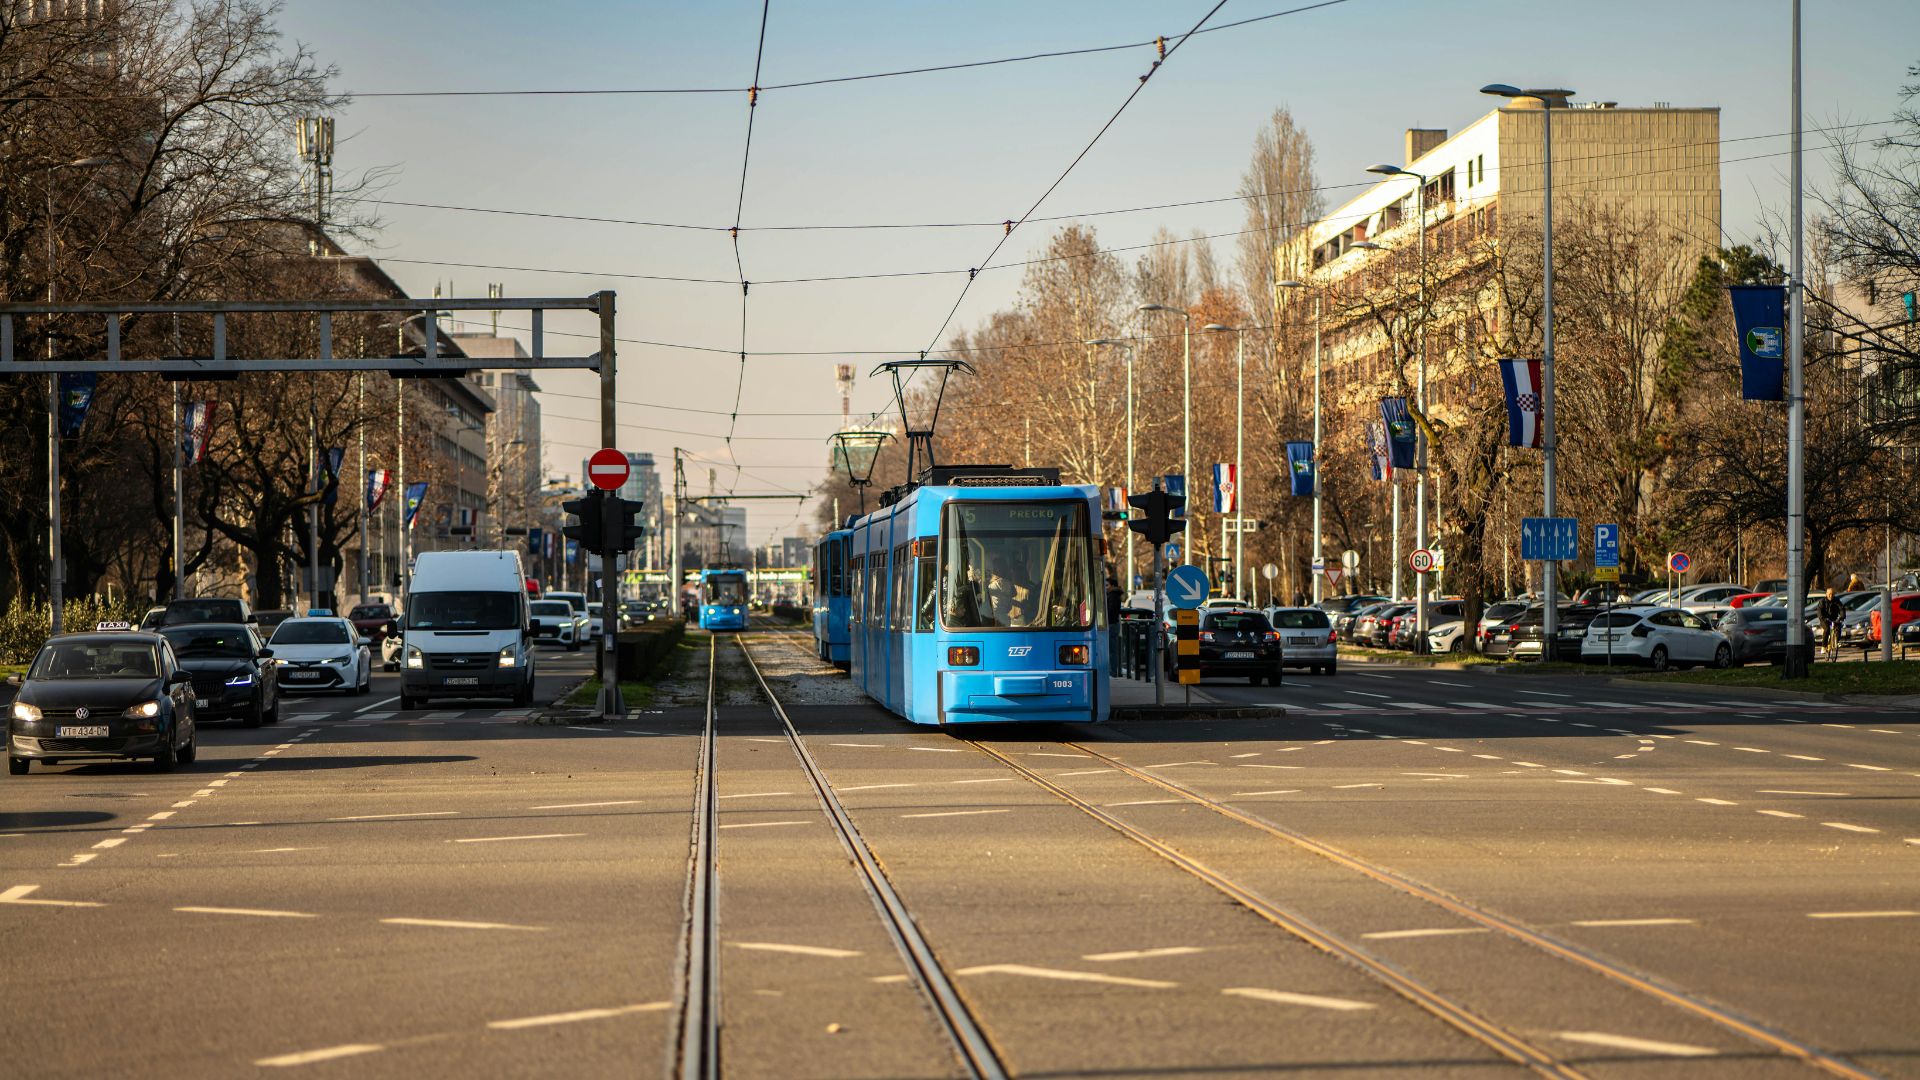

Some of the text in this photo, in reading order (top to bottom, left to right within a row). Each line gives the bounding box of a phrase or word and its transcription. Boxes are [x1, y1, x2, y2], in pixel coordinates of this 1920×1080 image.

[965, 508, 976, 524] 5
[1597, 527, 1609, 547] P
[1414, 555, 1428, 567] 60
[1008, 646, 1032, 657] ZET
[1052, 680, 1073, 688] 1003
